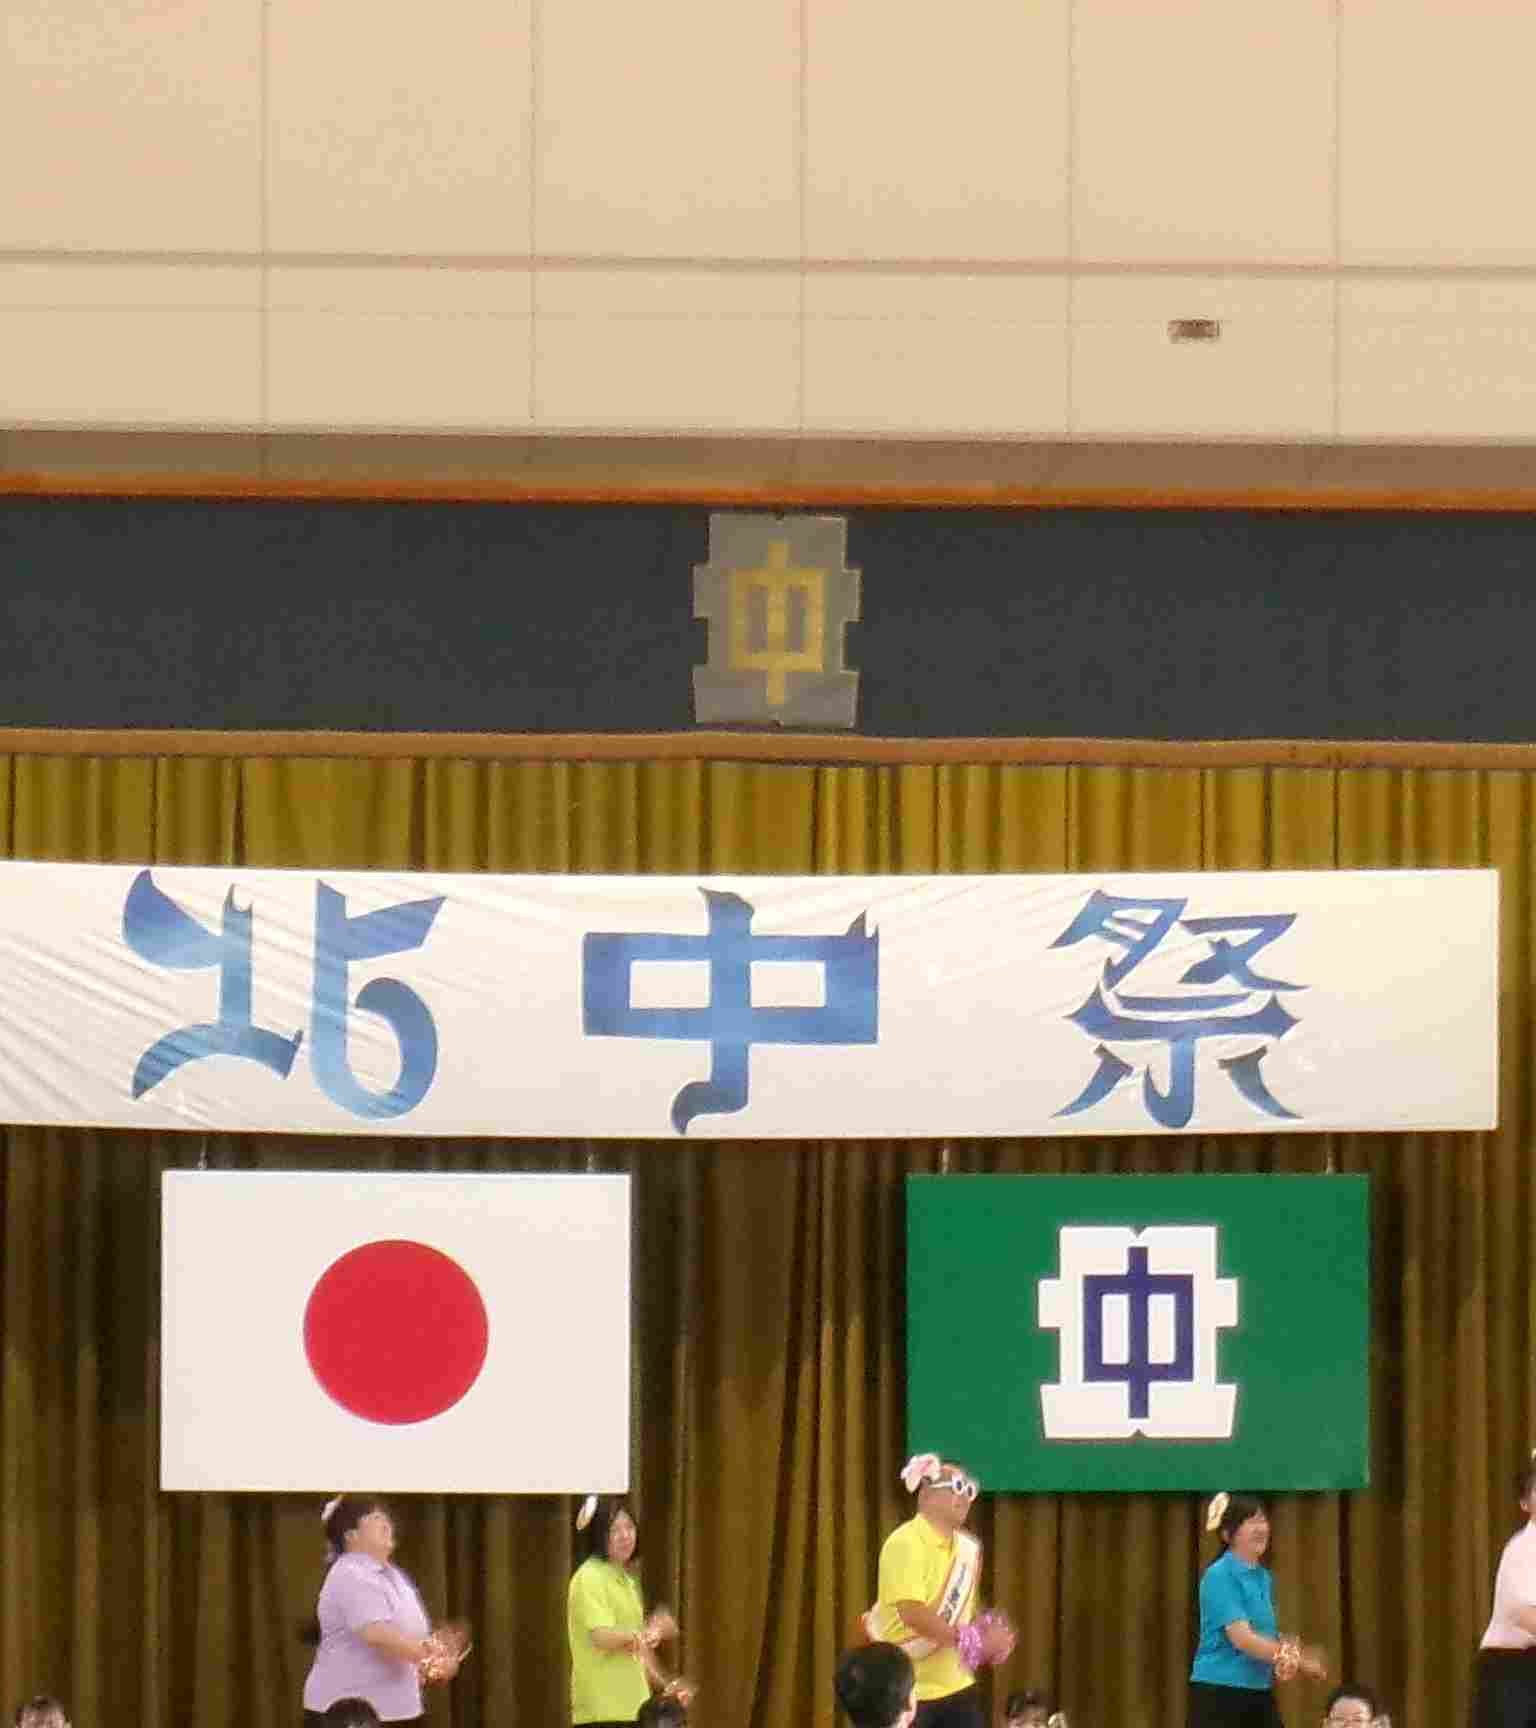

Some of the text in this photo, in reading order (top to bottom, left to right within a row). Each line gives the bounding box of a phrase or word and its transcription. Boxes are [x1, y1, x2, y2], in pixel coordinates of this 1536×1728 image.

[121, 868, 1312, 1135] 北中祭
[1082, 1246, 1194, 1419] 中
